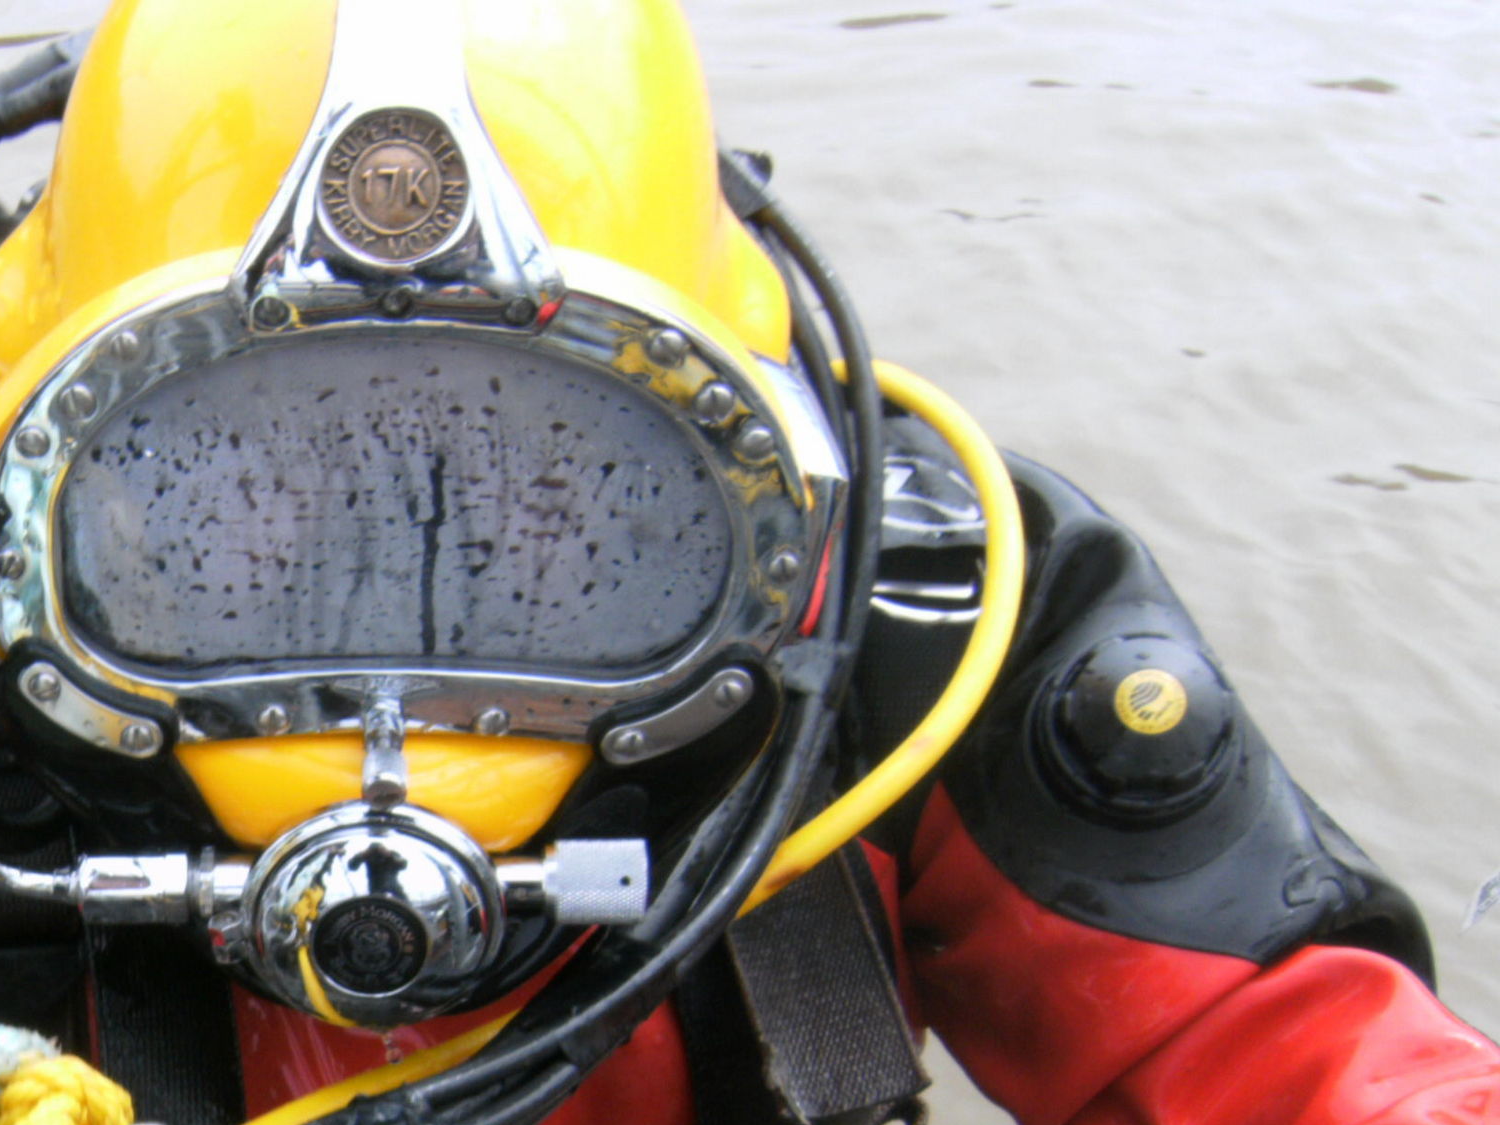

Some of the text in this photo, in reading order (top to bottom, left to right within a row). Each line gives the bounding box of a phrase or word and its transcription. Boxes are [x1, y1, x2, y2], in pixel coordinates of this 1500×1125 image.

[329, 113, 458, 173] SUPERLITE
[323, 178, 466, 255] KIRBY MORGAN
[361, 166, 430, 209] 17K
